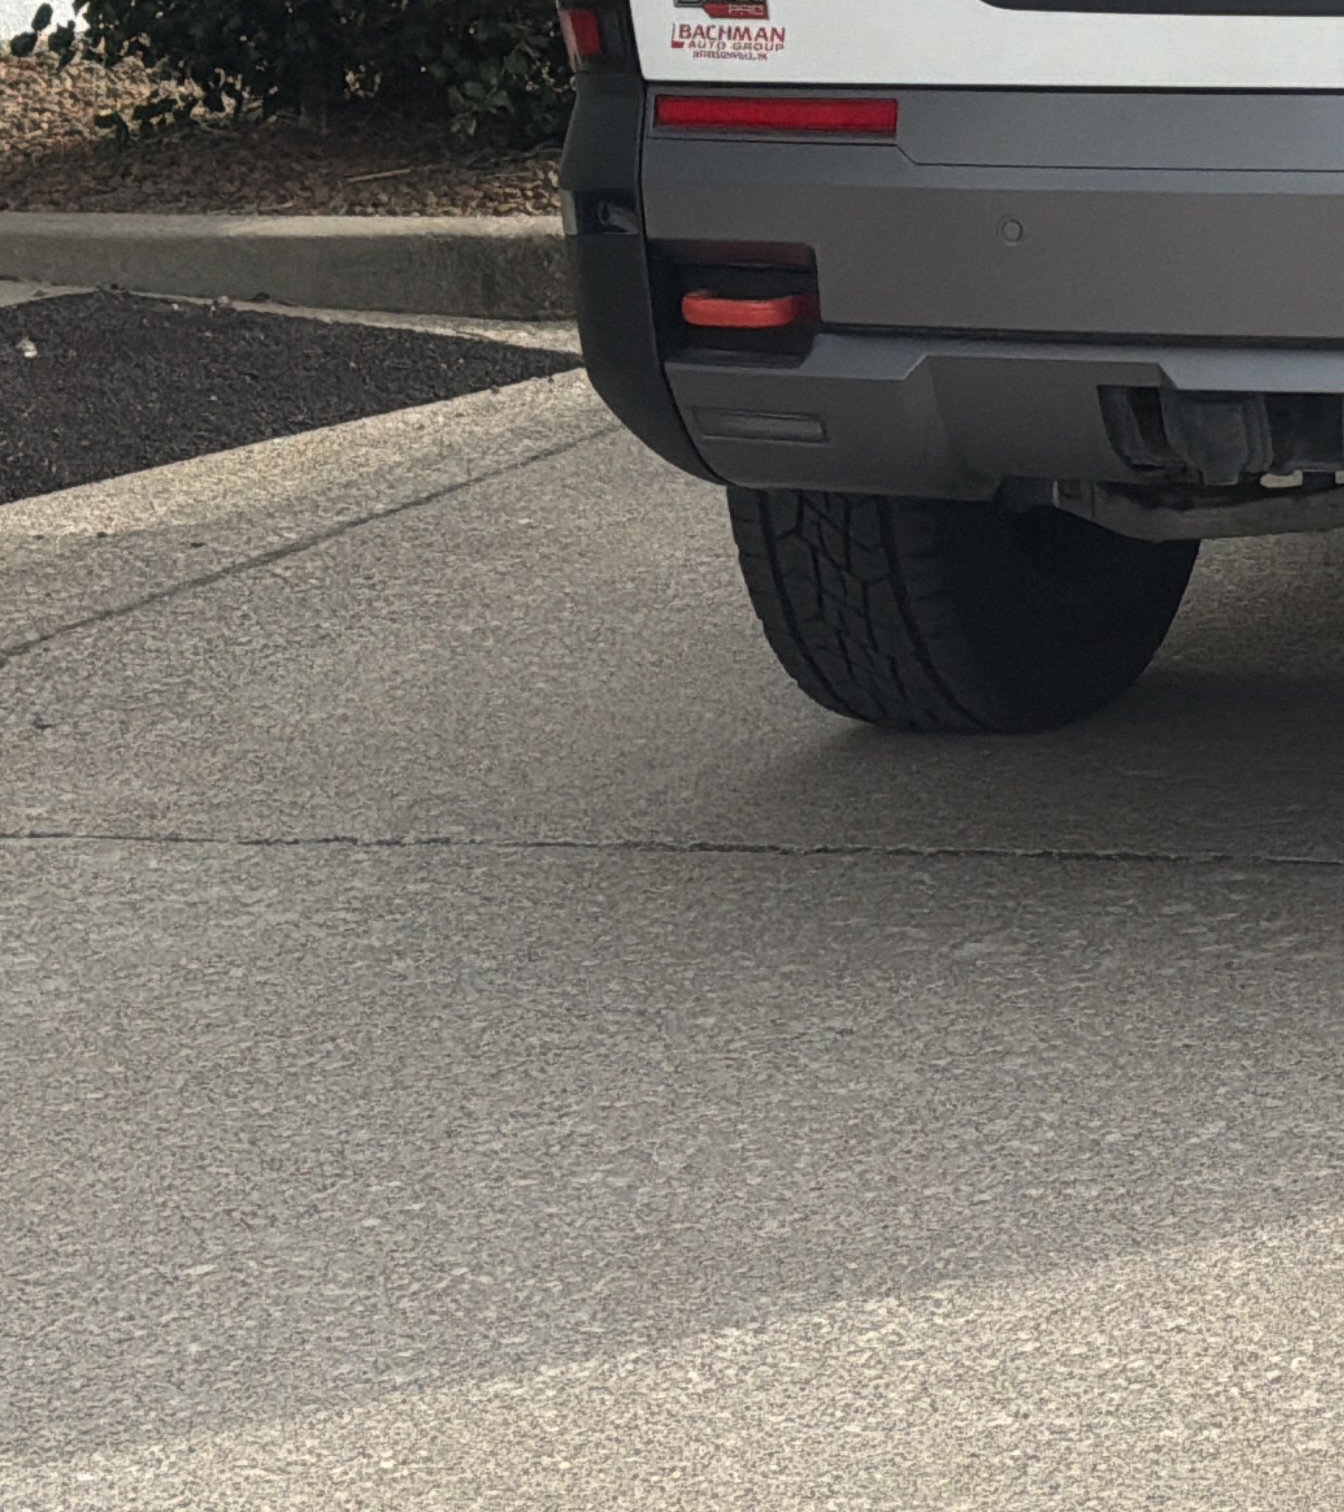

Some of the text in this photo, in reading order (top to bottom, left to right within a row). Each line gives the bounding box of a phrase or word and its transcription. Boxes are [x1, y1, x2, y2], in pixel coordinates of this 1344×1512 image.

[679, 23, 786, 42] BACHMAN
[688, 41, 785, 52] AUTO GROUP
